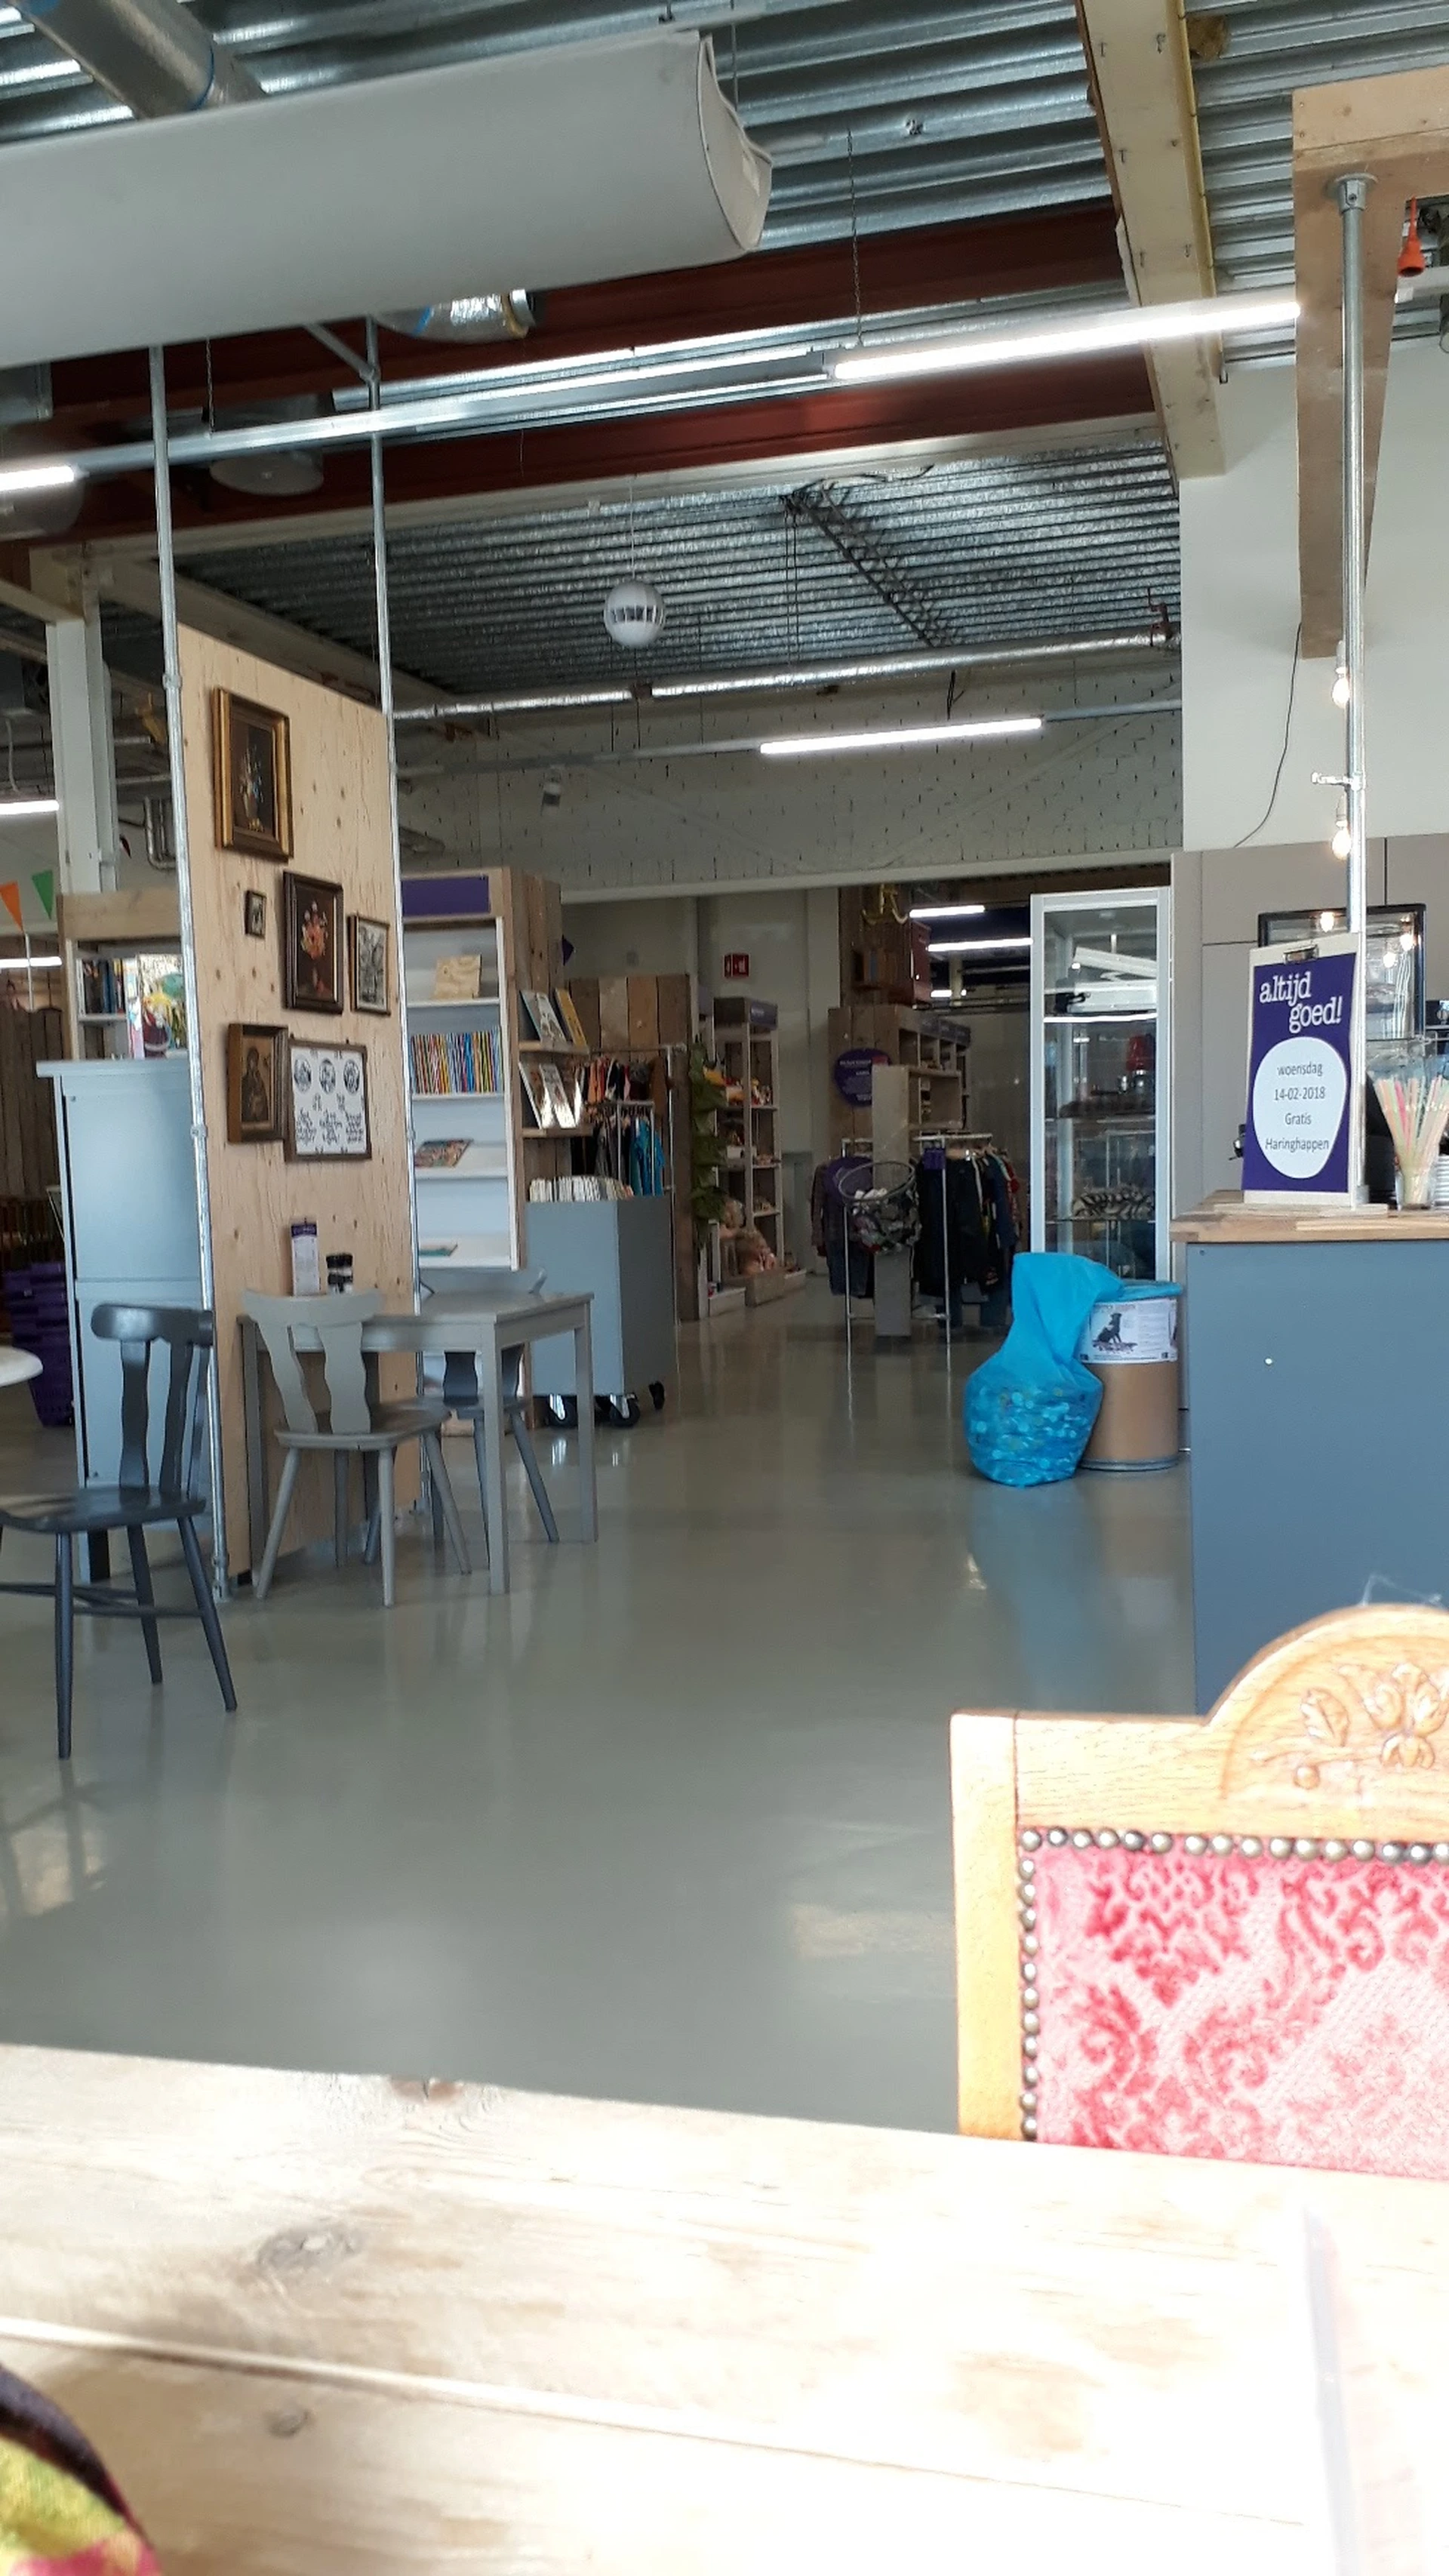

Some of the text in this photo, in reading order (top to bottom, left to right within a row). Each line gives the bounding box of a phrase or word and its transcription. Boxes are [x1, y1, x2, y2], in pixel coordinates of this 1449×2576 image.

[1259, 971, 1312, 1006] altijd
[1289, 996, 1343, 1033] goed!
[1277, 1061, 1323, 1076] woensdag
[1274, 1086, 1325, 1100] 14-02-2018
[1284, 1112, 1312, 1125] Gratis
[1265, 1137, 1329, 1153] Haringhappen
